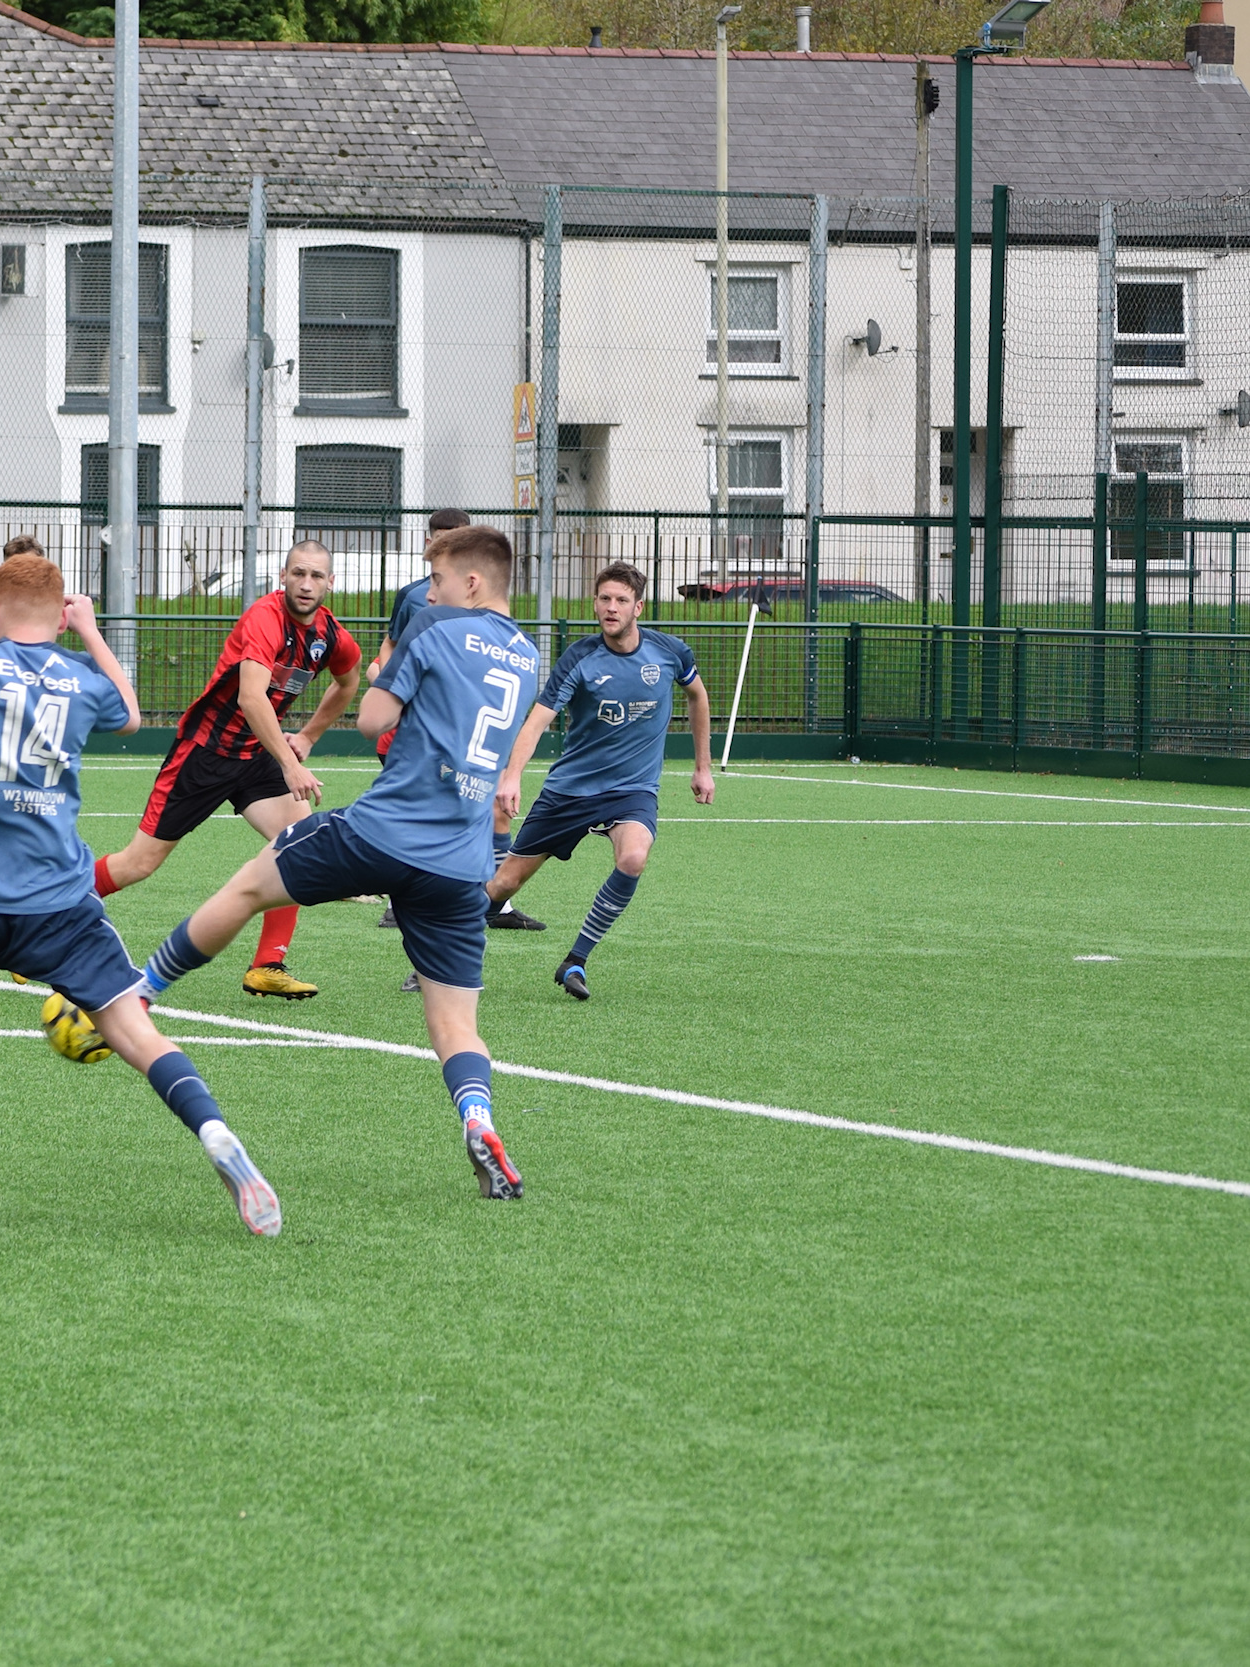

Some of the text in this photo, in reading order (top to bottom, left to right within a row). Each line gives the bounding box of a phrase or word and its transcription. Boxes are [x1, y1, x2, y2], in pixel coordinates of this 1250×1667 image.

[465, 634, 536, 674] Everest
[465, 667, 521, 771] 2
[454, 771, 469, 786] W2
[2, 789, 67, 805] W2 WINDOW
[13, 801, 58, 816] SYSTEMS
